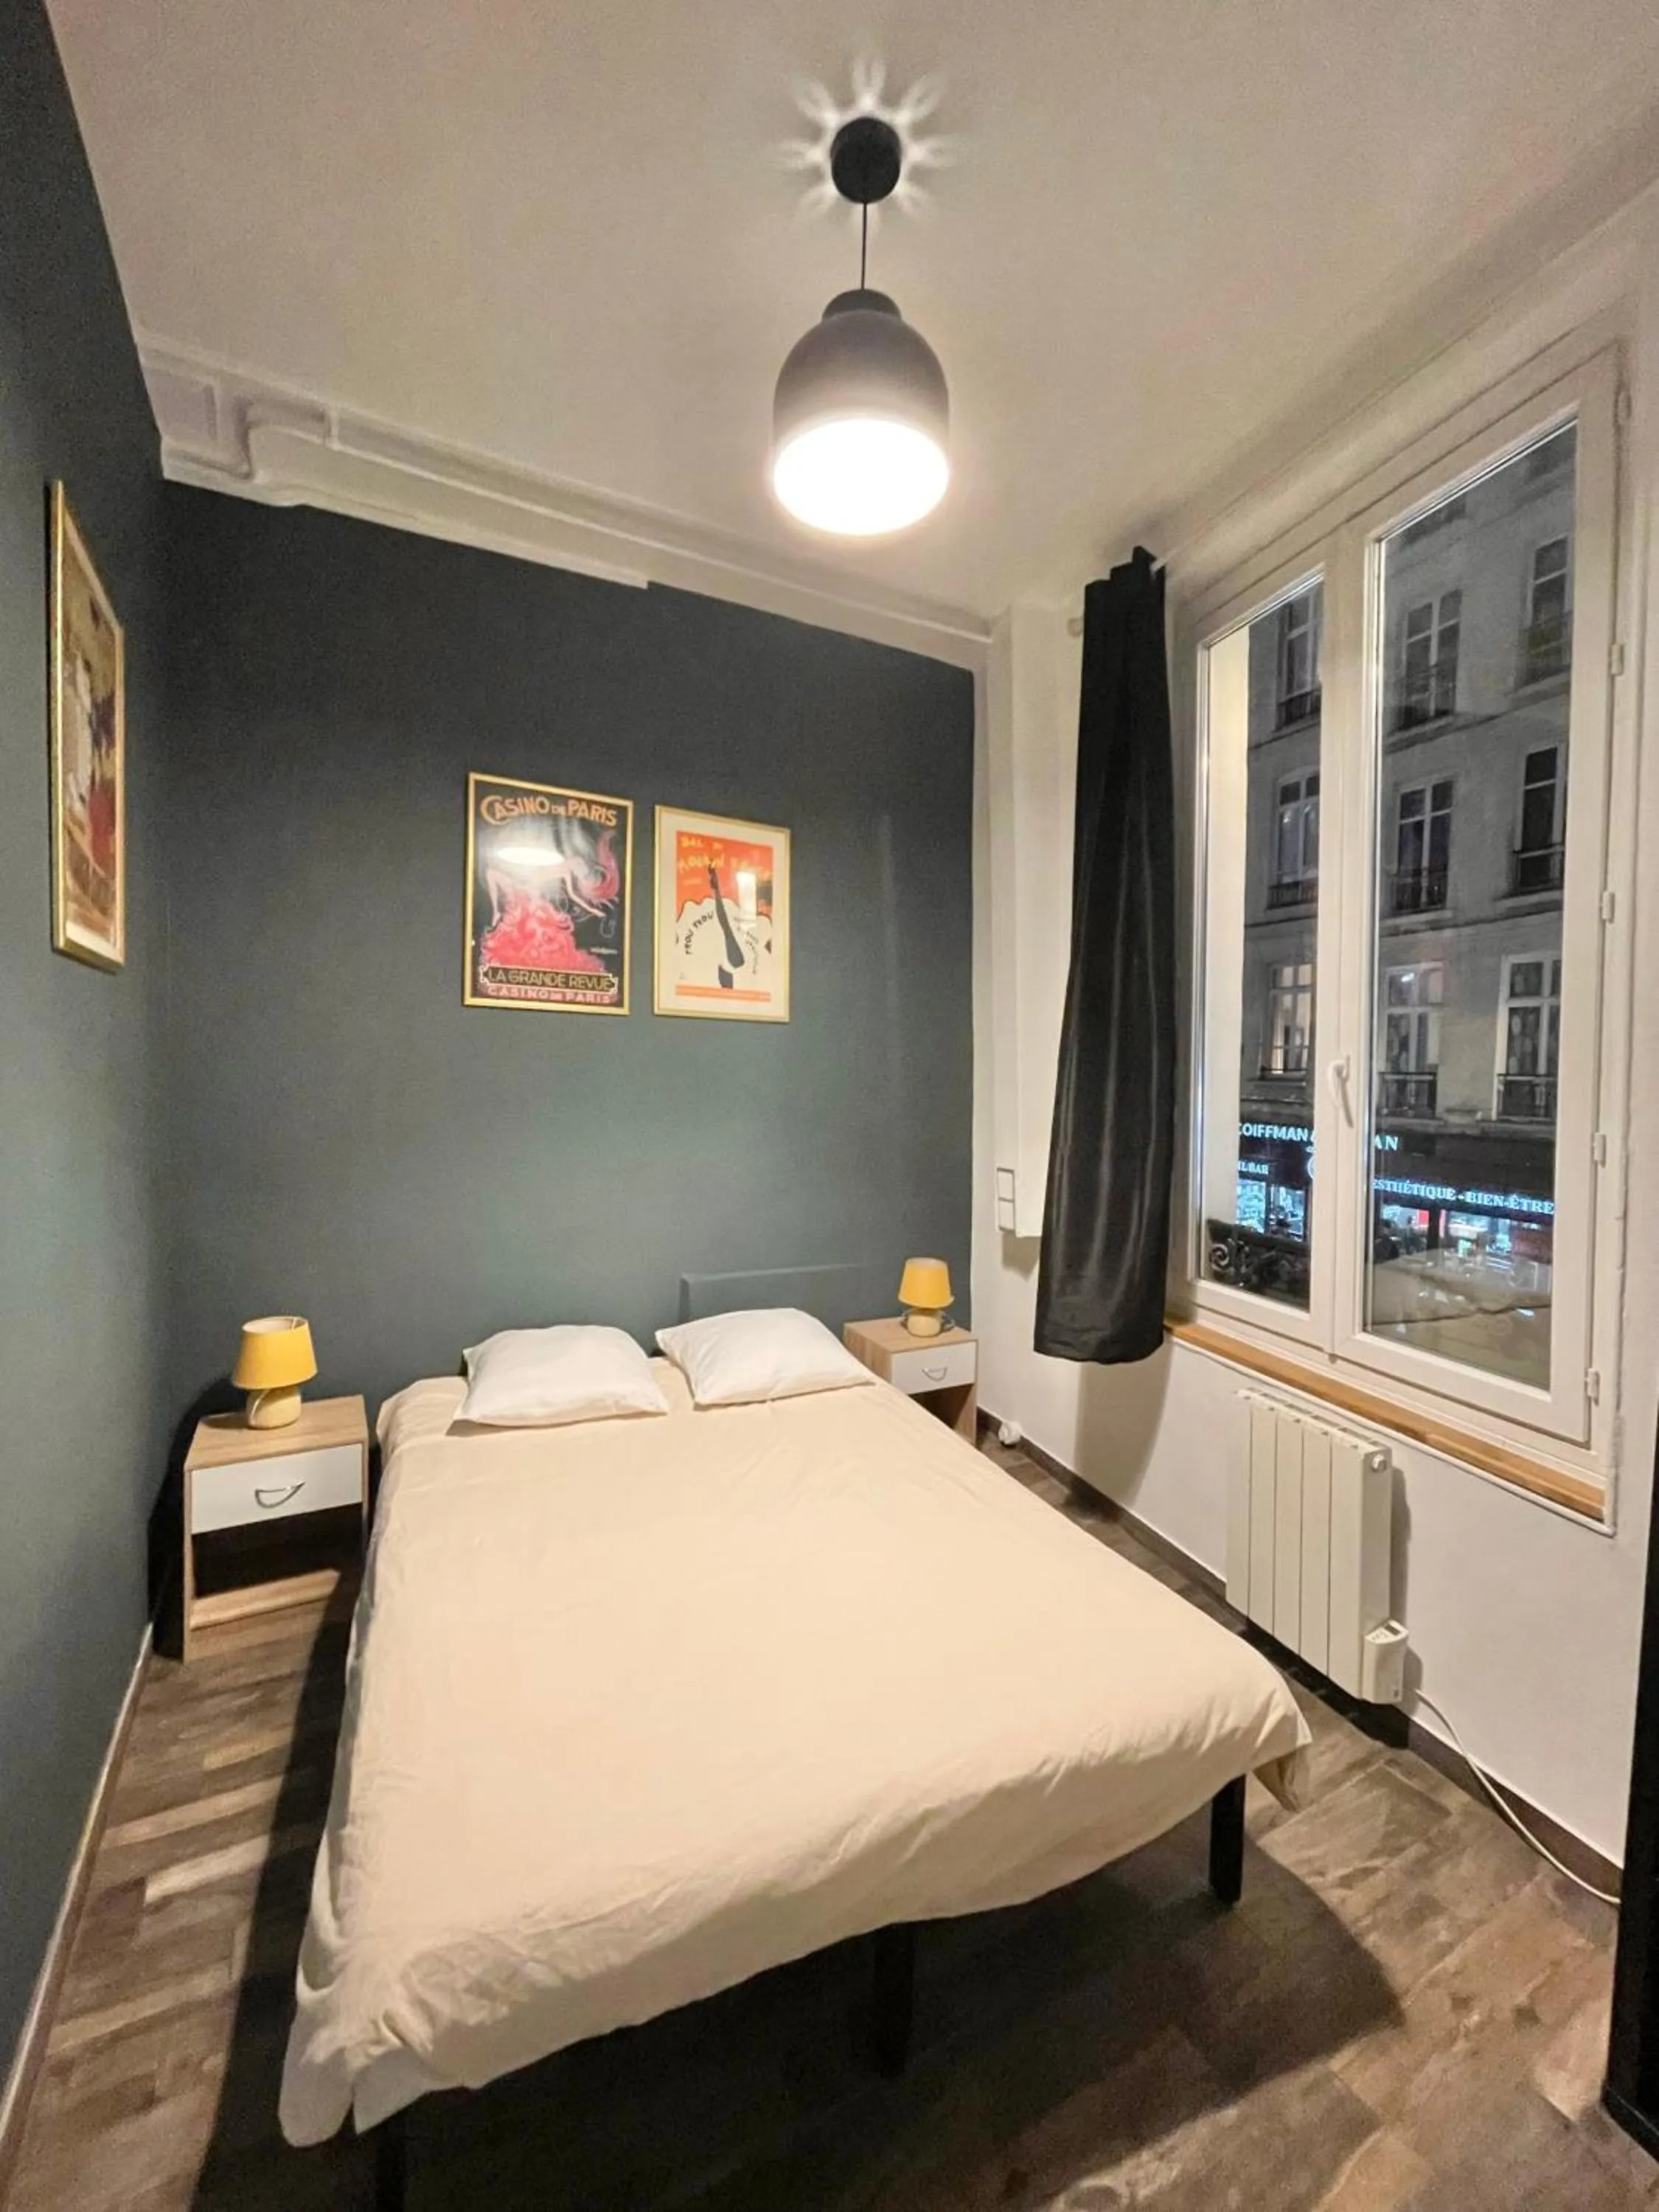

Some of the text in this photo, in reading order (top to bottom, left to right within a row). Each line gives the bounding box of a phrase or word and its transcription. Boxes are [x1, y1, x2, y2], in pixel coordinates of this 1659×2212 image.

[481, 795, 550, 825] CASINO
[567, 799, 617, 827] PARIS
[489, 969, 613, 991] LA GRANDE REVUE
[487, 987, 549, 999] CASINO
[565, 992, 611, 1004] PARIS
